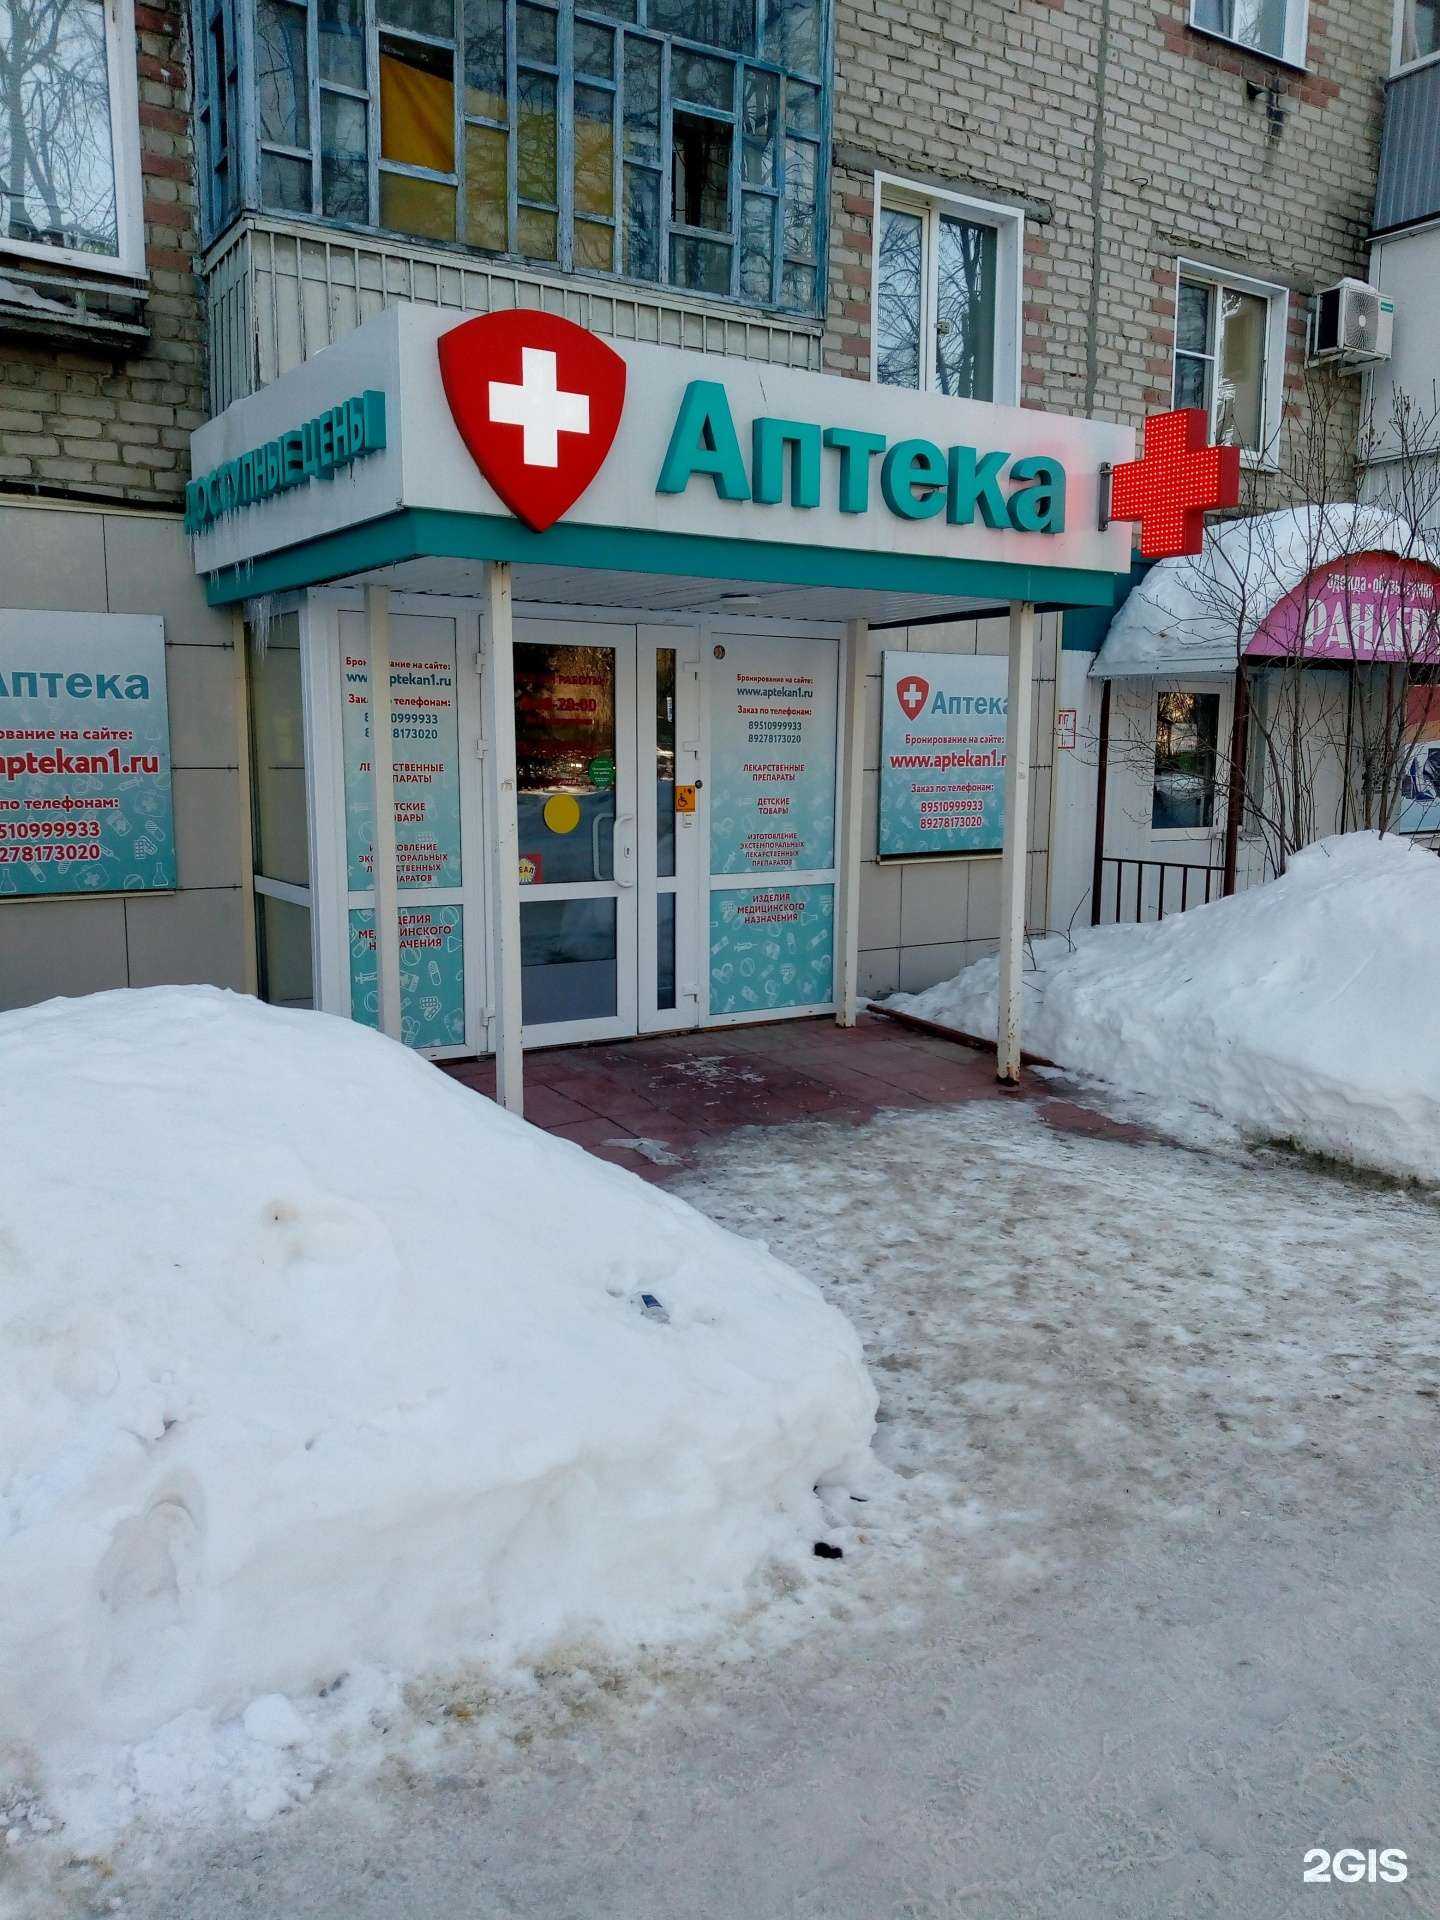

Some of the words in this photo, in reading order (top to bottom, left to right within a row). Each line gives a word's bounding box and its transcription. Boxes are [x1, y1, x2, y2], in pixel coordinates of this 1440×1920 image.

[301, 389, 387, 480] ЦЕНЫ
[656, 379, 1067, 535] Аптека
[424, 661, 451, 670] сайте:
[737, 673, 784, 684] Бронирование
[736, 686, 813, 699] www.aptekan1.ru
[394, 696, 451, 707] телефонам:
[737, 705, 759, 714] Заказ
[770, 706, 812, 717] телефонам:
[748, 720, 802, 731] 89510999933
[60, 730, 79, 740] на
[83, 728, 133, 741] сайте:
[748, 734, 802, 744] 89278173020
[905, 734, 967, 746] Бронирование
[969, 737, 978, 745] на
[980, 734, 1005, 744] сайте:
[743, 763, 805, 772] ЛЕКАРСТВЕННЫЕ
[752, 773, 796, 782] ПРЕПАРАТЫ
[911, 783, 934, 793] Заказ
[936, 785, 946, 793] по
[947, 782, 994, 794] телефонам:
[24, 796, 119, 812] телефонам:
[757, 797, 791, 806] ДЕТСКИЕ
[921, 800, 983, 813] 89510999933
[758, 807, 789, 815] ТОВАРЫ
[920, 816, 982, 829] 89278173020
[745, 850, 800, 859] ЛЕКАРСТВЕННЫХ
[752, 892, 791, 904] ИЗДЕЛИЯ
[737, 902, 805, 916] МЕДИЦИНСКОГО
[744, 913, 799, 925] НАЗНАЧЕНИЯ
